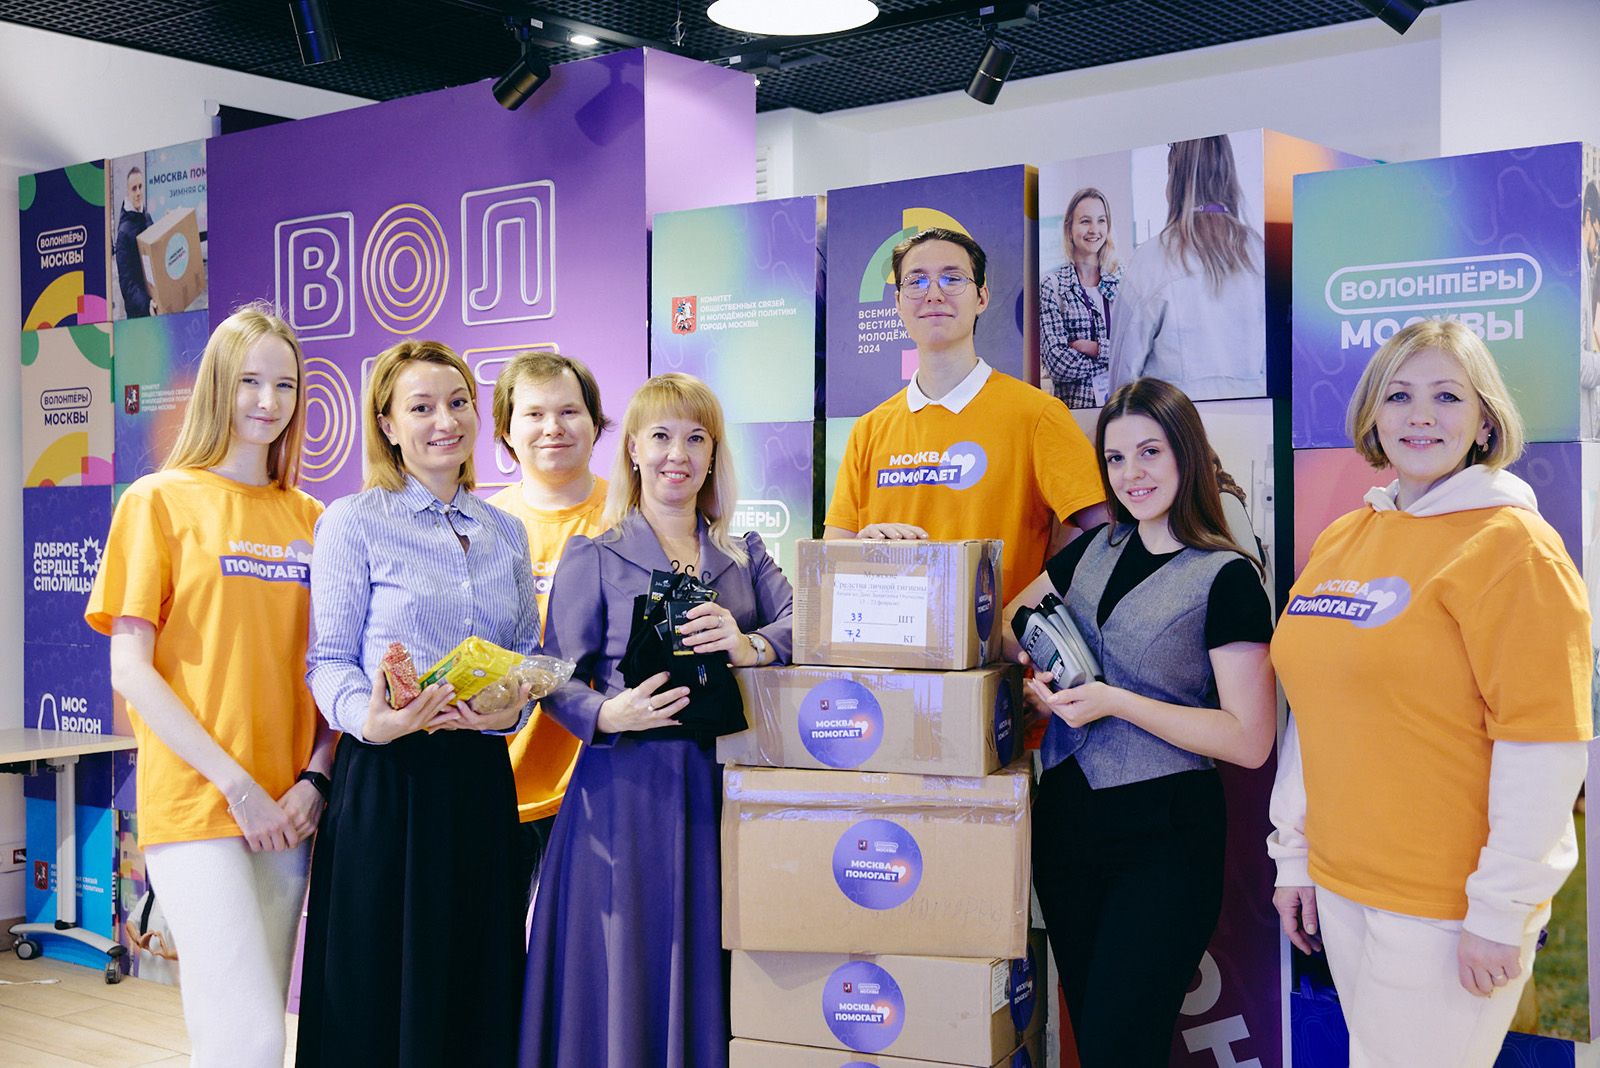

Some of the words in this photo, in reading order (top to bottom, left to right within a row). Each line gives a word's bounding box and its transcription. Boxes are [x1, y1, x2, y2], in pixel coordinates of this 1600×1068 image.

[40, 250, 84, 269] МОСКВЫ
[1340, 265, 1524, 302] ВОЛОНТЁРЫ
[758, 307, 797, 317] ПОЛИТИКИ
[700, 322, 727, 330] ГОРОДА
[858, 329, 910, 342] МОЛОДЁЖ
[858, 344, 880, 354] 2024
[44, 410, 89, 426] МОСКВЫ
[889, 451, 951, 466] МОСКВА
[878, 468, 959, 485] ПОМОГАЕТ
[33, 542, 79, 560] ДОБРОЕ
[228, 540, 297, 558] МОСКВА
[33, 559, 79, 577] СЕРДЦЕ
[225, 559, 307, 579] ПОМОГАЕТ
[1291, 599, 1371, 618] ПОМОГАЕТ
[851, 612, 863, 622] 33
[898, 615, 915, 624] ШТ
[903, 635, 916, 643] КГ
[61, 696, 88, 713] МОС
[815, 719, 854, 728] МОСКВА
[811, 729, 860, 738] ПОМОГАЕТ
[851, 860, 892, 870] МОСКВА
[845, 869, 898, 881] ПОМОГАЕТ
[839, 1003, 877, 1012] МОСКВА
[835, 1012, 883, 1022] ПОМОГАЕТ
